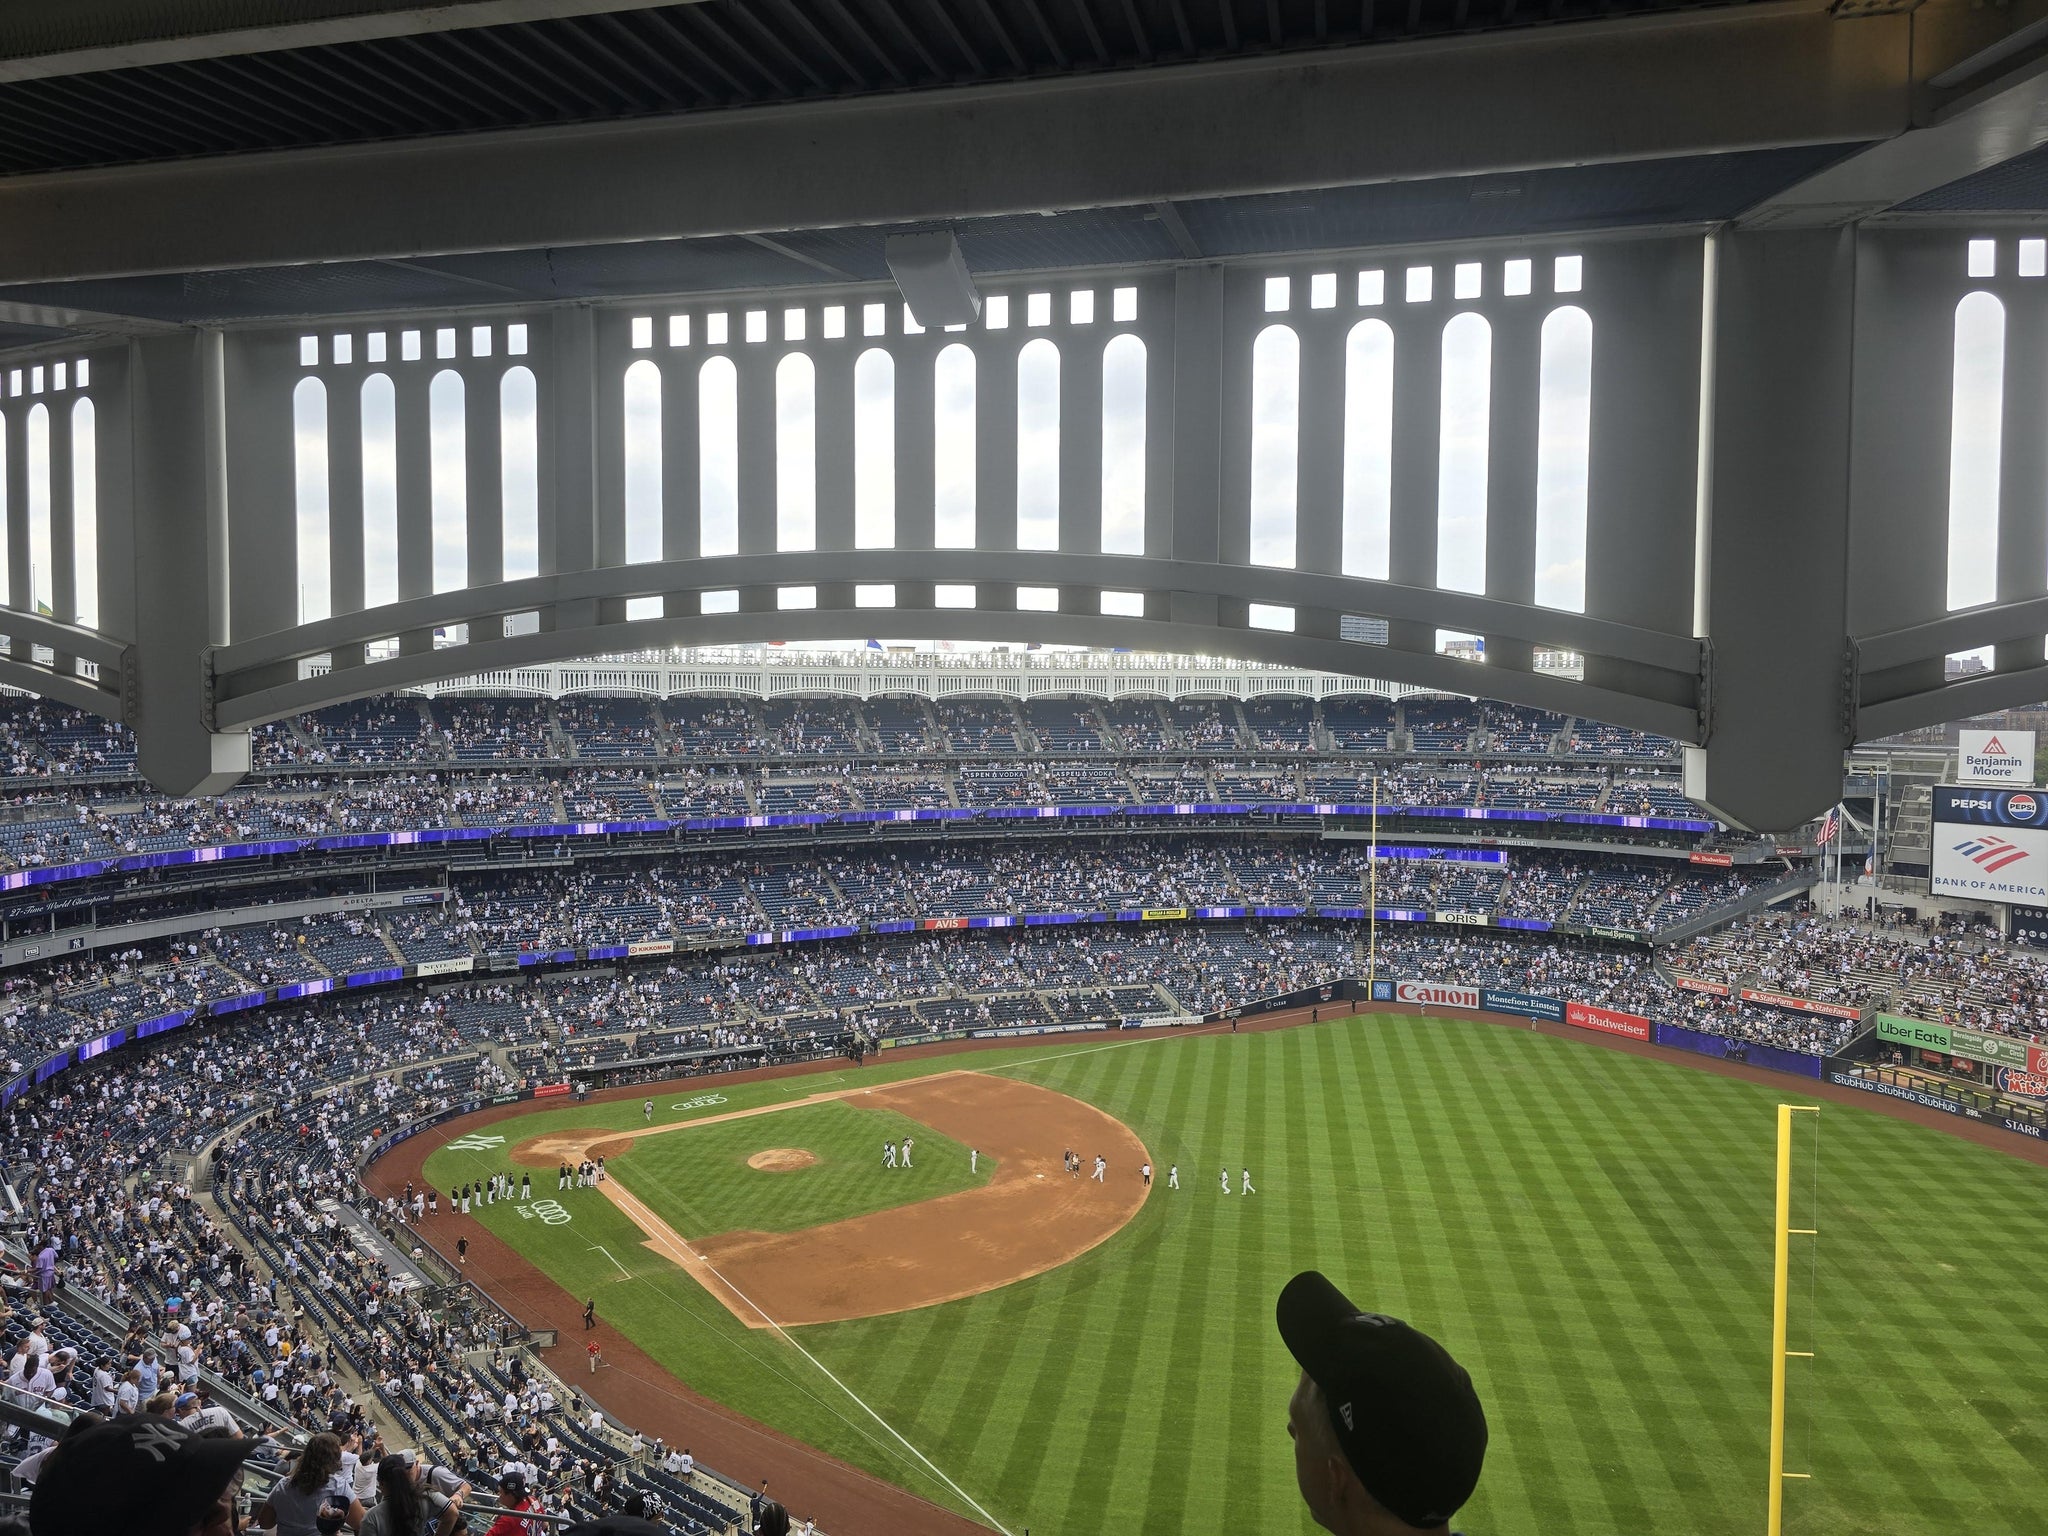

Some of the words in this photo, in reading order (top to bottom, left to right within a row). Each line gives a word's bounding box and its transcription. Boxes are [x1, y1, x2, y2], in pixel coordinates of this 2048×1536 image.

[1966, 755, 2022, 768] Benjamin
[1973, 766, 2012, 777] Moore
[1951, 799, 1992, 810] PEPSI
[2009, 803, 2035, 811] PEPSI
[1935, 877, 1967, 888] BANK
[1971, 881, 1986, 889] OF
[1989, 882, 2046, 896] AMERICA
[9, 905, 44, 917] 27-Time
[46, 899, 71, 912] World
[71, 894, 111, 907] Champions
[934, 919, 959, 929] AVIS
[1445, 913, 1478, 924] ORIS
[1592, 926, 1613, 937] Poland
[1613, 929, 1636, 942] Spring
[638, 944, 671, 952] KIKKOMAN
[1397, 984, 1477, 1006] Canon
[1486, 993, 1529, 1007] Montefiore
[1530, 1000, 1560, 1012] Einstein
[1587, 1013, 1646, 1036] Budweiser
[1880, 1021, 1912, 1038] Uber
[1914, 1029, 1948, 1046] Eats
[1833, 1074, 1874, 1091] StubHub
[1877, 1083, 1916, 1101] StubHub
[1918, 1094, 1957, 1113] StubHub
[1965, 1107, 1979, 1118] 399
[2005, 1118, 2041, 1137] STARR
[513, 1205, 536, 1220] Audi
